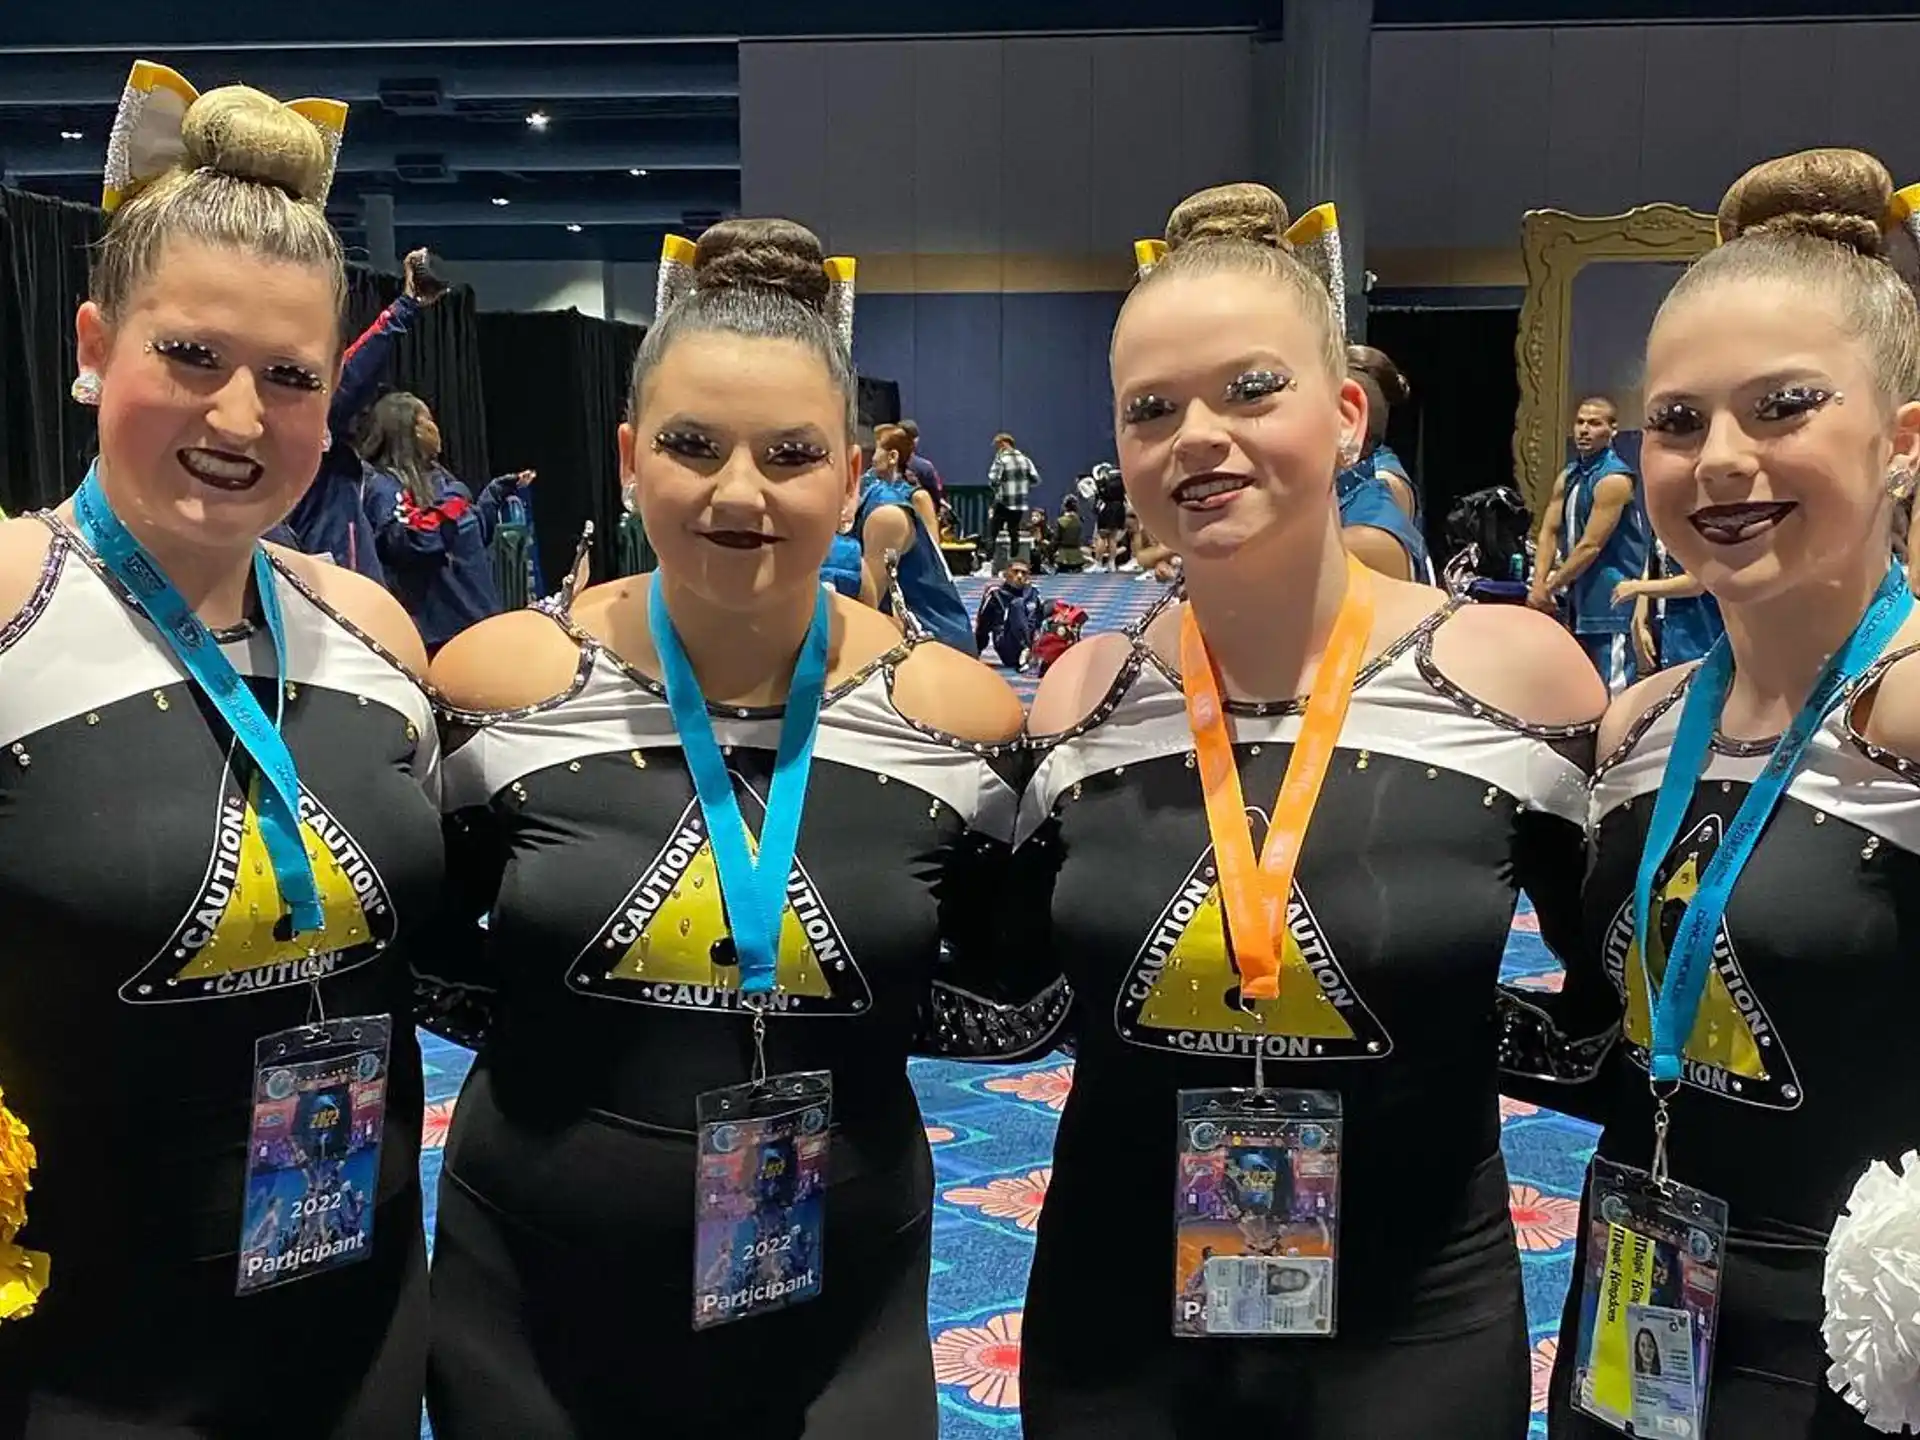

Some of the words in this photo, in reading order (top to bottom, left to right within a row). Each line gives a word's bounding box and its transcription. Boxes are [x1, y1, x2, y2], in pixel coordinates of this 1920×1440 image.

[182, 804, 246, 949] CAUTION
[299, 795, 381, 911] CAUTION
[611, 827, 702, 945] CAUTION
[787, 869, 841, 962] UTION
[1130, 878, 1209, 1000] CAUTION
[1287, 890, 1353, 1008] AUTION
[216, 954, 336, 994] CAUTION
[1713, 933, 1768, 1035] UTION
[290, 1193, 341, 1219] 2022
[743, 1235, 791, 1261] 2022
[248, 1230, 366, 1277] Participant
[703, 1268, 814, 1313] Participant
[1607, 1269, 1623, 1322] Kingdom
